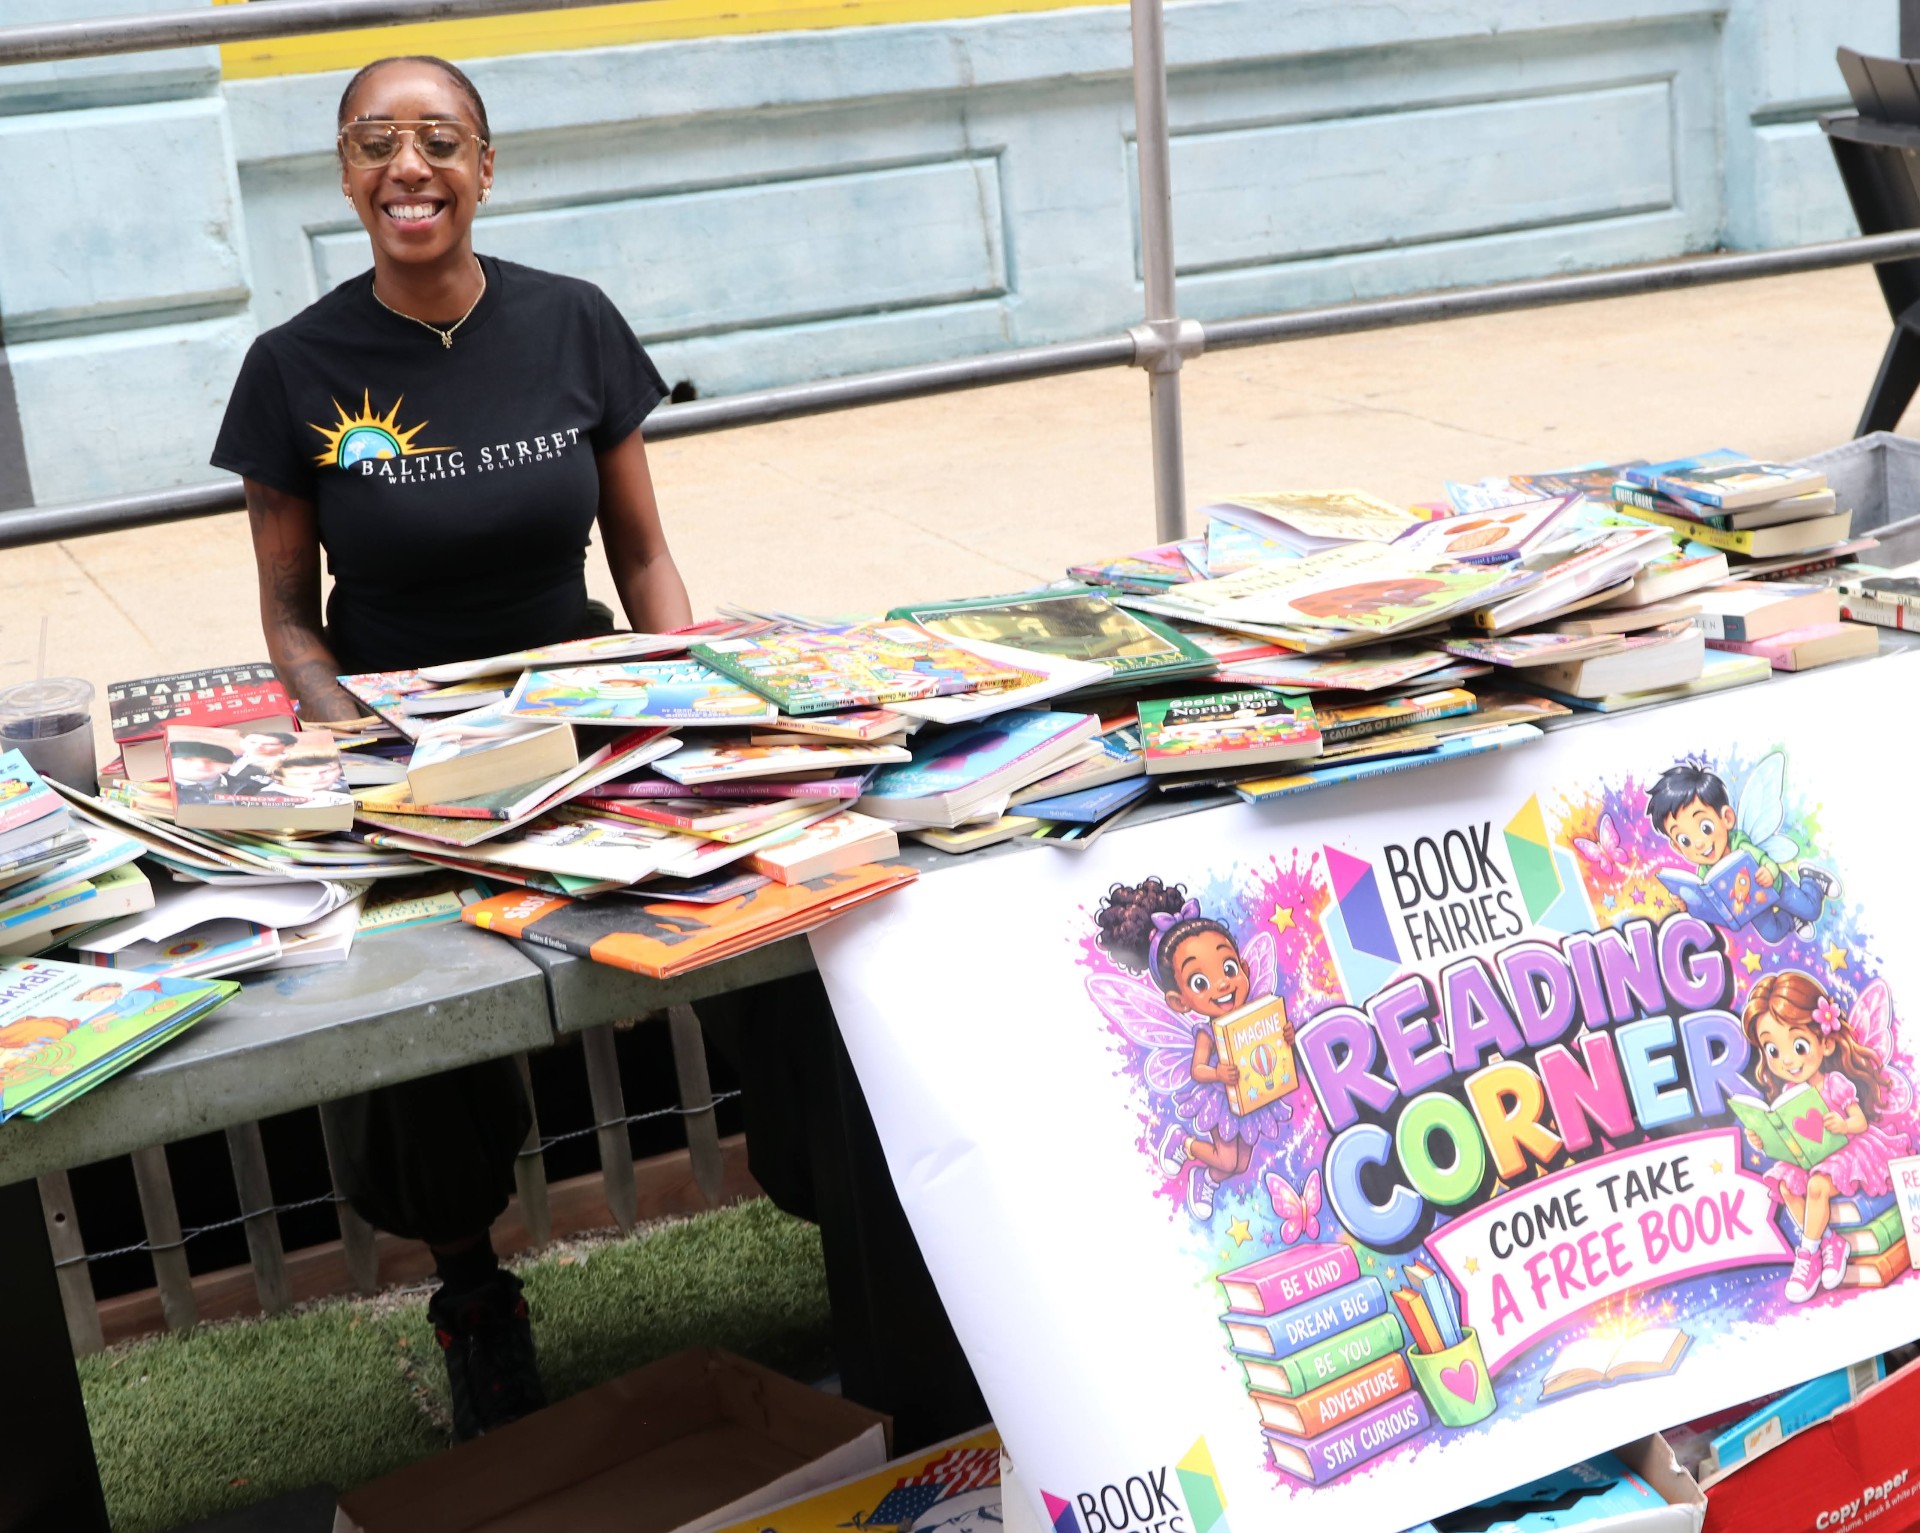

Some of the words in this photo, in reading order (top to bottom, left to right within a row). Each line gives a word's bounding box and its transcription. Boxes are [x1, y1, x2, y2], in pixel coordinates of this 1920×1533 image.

[361, 451, 465, 476] BALTIC
[481, 427, 581, 465] STREET
[388, 467, 467, 485] WELLNESS
[477, 450, 564, 472] SOLUTIONS
[1616, 487, 1633, 504] WHITE
[1634, 490, 1653, 511] SHARK
[108, 668, 275, 702] BELIEVER
[150, 683, 238, 705] TRUE
[205, 693, 283, 713] JACK
[1169, 695, 1215, 708] Good
[1221, 691, 1275, 703] Night
[112, 706, 192, 729] CARR
[1172, 705, 1231, 718] North
[1238, 699, 1278, 710] Pole
[1329, 723, 1373, 742] CATALOG
[1374, 720, 1388, 731] OF
[1390, 708, 1441, 726] HANUKKAH
[1383, 821, 1507, 909] BOOK
[502, 893, 556, 920] sist
[1403, 889, 1523, 961] FAIRIES
[0, 968, 64, 1006] kkah
[1233, 1011, 1282, 1051] IMAGINE
[1300, 917, 1729, 1130] READING
[1324, 1010, 1760, 1248] CORNER
[1488, 1184, 1589, 1260] COME
[1596, 1155, 1695, 1214] TAKE
[1281, 1275, 1303, 1301] BE
[1306, 1260, 1341, 1292] KIND
[1490, 1289, 1524, 1336] A
[1528, 1232, 1637, 1313] FREE
[1642, 1188, 1753, 1269] BOOK
[1286, 1307, 1339, 1345] DREAM
[1342, 1295, 1369, 1321] BIG
[1313, 1355, 1336, 1379] BE
[1339, 1337, 1372, 1364] YOU
[1318, 1368, 1399, 1424] ADVENTURE
[1323, 1438, 1358, 1469] STAY
[1359, 1405, 1419, 1451] CURIOUS
[1077, 1466, 1180, 1533] BOOK
[1816, 1498, 1860, 1530] Copy
[1863, 1468, 1909, 1506] Paper
[1864, 1503, 1884, 1522] black
[1884, 1500, 1891, 1511] &
[1891, 1488, 1910, 1506] white
